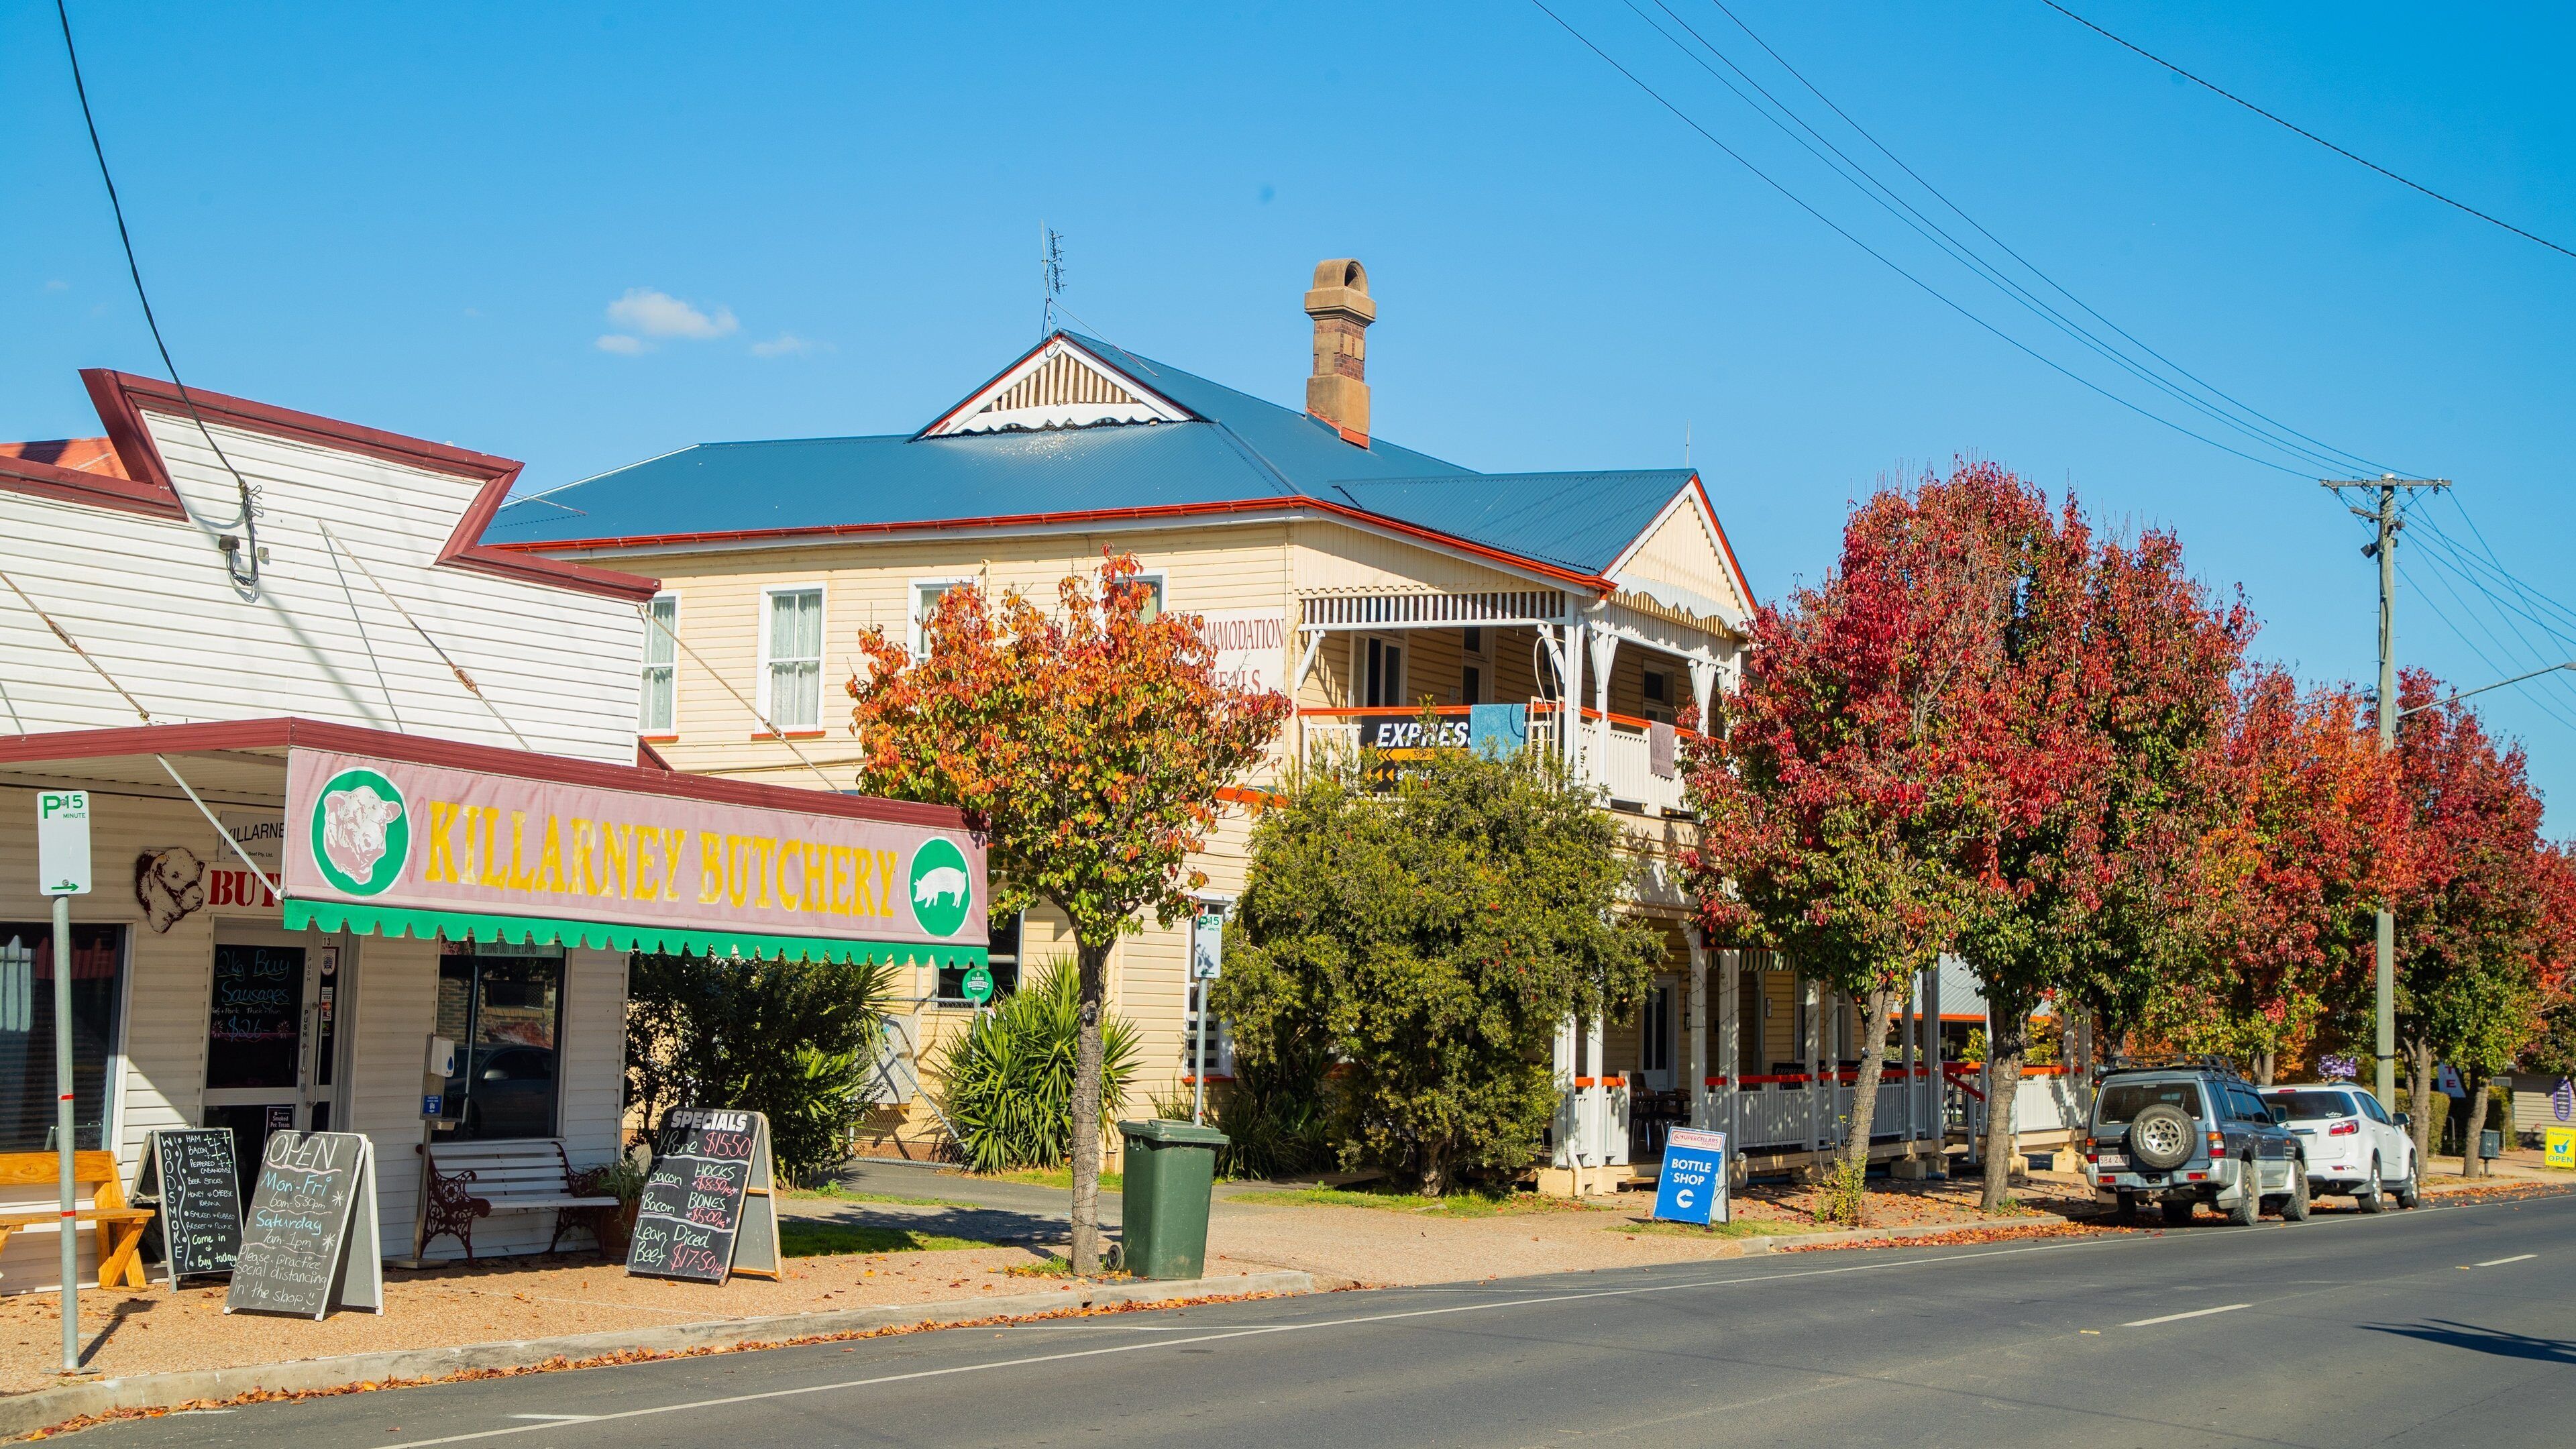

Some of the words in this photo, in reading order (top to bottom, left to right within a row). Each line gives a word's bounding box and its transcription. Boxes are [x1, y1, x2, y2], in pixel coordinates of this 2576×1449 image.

[1377, 722, 1471, 747] EXPRES
[425, 800, 687, 903] KILLARNEY
[698, 831, 900, 918] BUTCHERY
[323, 936, 331, 946] 13
[481, 942, 498, 954] BRING
[511, 943, 521, 955] THE
[521, 943, 537, 955] LAMB
[215, 951, 245, 982] 2kg
[254, 949, 290, 981] Buy
[221, 979, 290, 1010] Sausages
[671, 1110, 748, 1132] SPECIALS
[186, 1134, 201, 1143] HAM
[269, 1134, 339, 1170] OPEN
[2548, 1155, 2573, 1163] OPEN
[189, 1159, 215, 1168] PEPPERED
[649, 1163, 682, 1186] Bacon
[695, 1162, 737, 1180] HOCKS
[1671, 1158, 1712, 1173] BOTTLE
[187, 1177, 201, 1185] BEER
[1672, 1172, 1705, 1186] SHOP
[188, 1191, 204, 1199] HONEY
[213, 1189, 233, 1197] CHEESE
[642, 1191, 676, 1214] Bacon
[687, 1191, 727, 1210] BONES
[256, 1210, 322, 1236] Saturday
[635, 1218, 667, 1242] Lean
[673, 1224, 711, 1248] Diced
[192, 1234, 214, 1245] Come
[218, 1233, 226, 1242] in
[198, 1254, 213, 1271] Buy
[215, 1252, 237, 1267] today
[633, 1238, 668, 1268] Beef
[270, 1267, 328, 1291] distancing
[233, 1275, 245, 1297] in
[252, 1281, 270, 1299] the
[272, 1286, 304, 1306] shop
